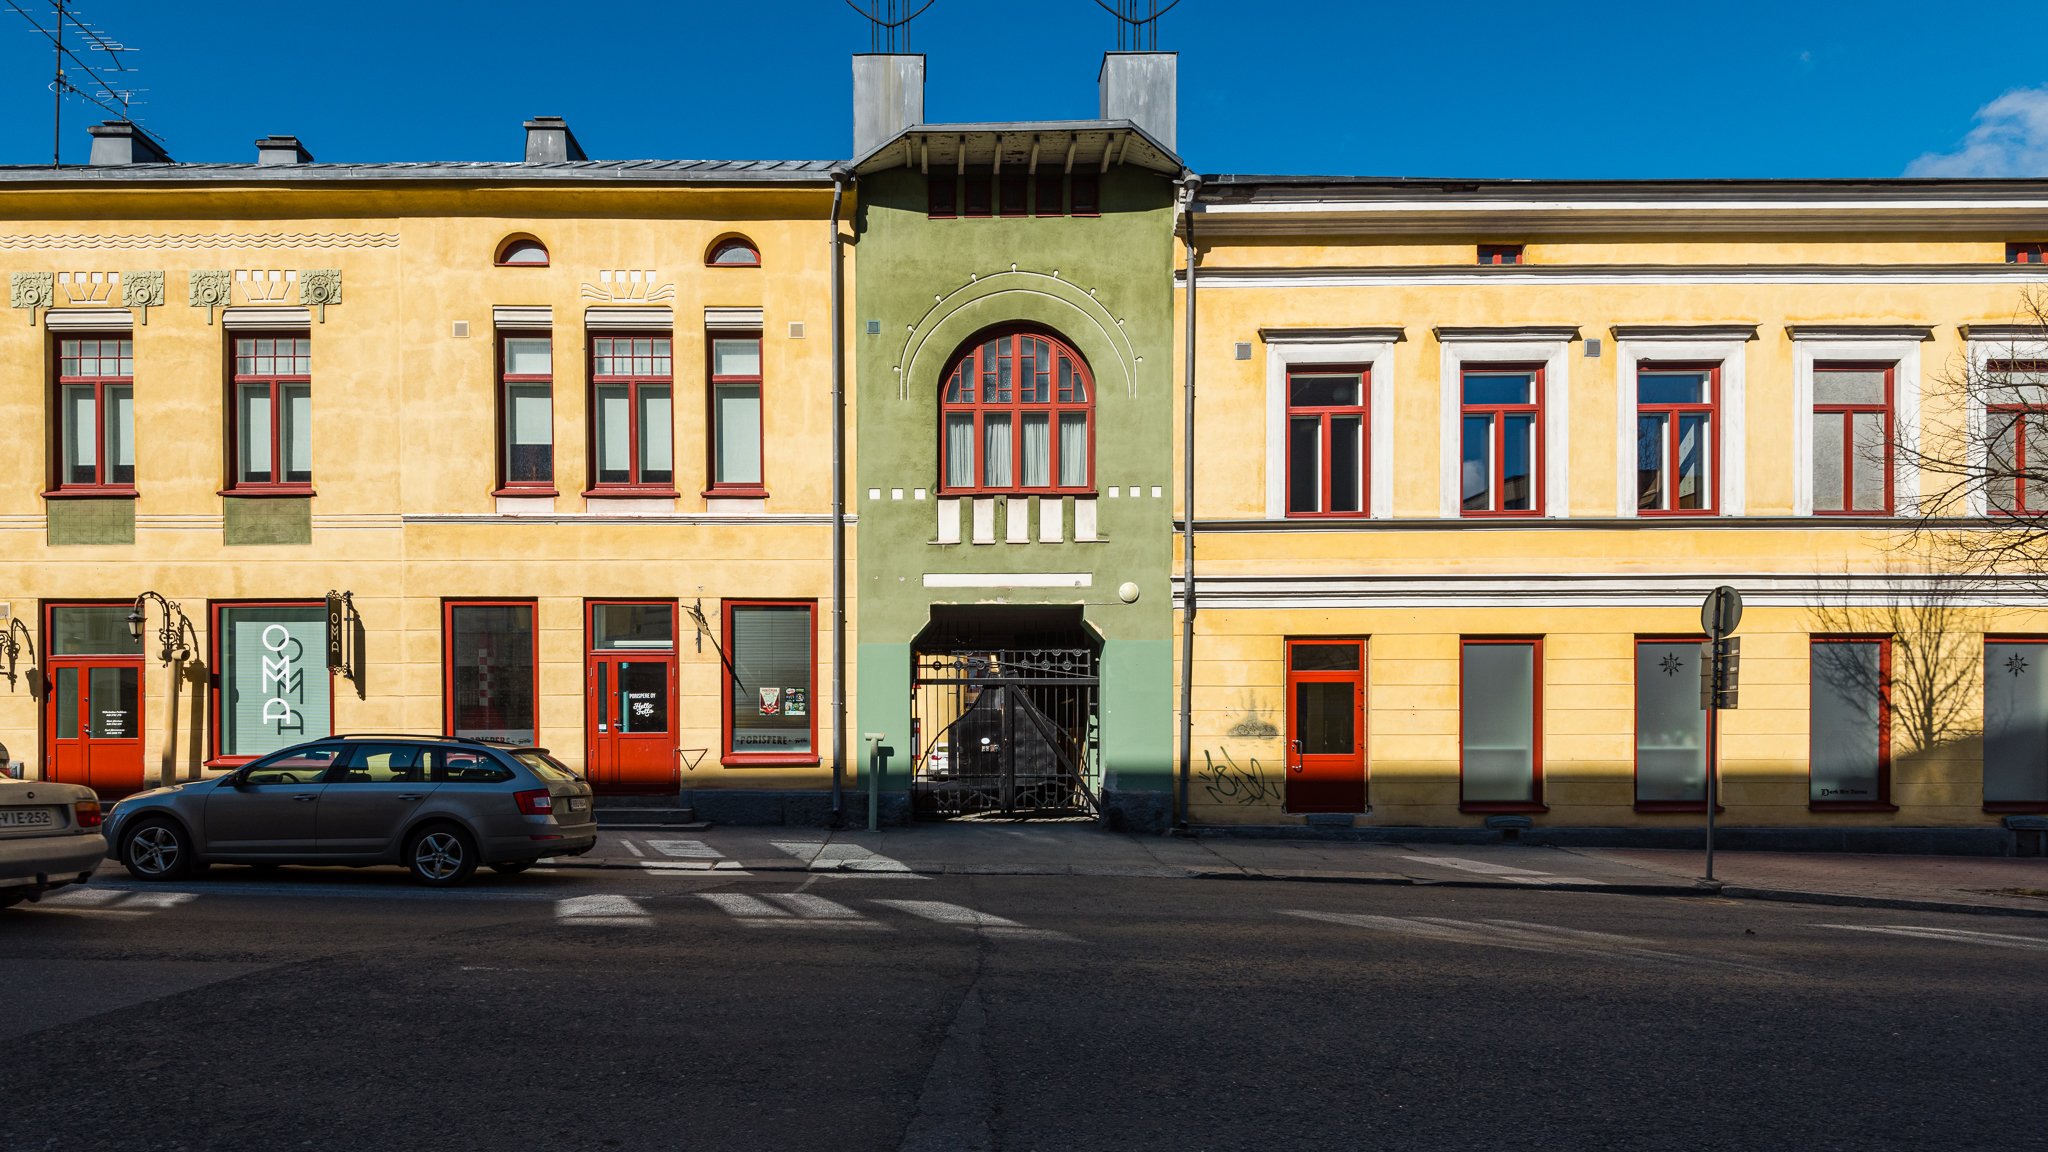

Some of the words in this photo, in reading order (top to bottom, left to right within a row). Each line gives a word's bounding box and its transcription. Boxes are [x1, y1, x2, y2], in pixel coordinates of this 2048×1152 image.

[331, 613, 339, 652] OMA
[262, 624, 290, 724] OMA
[740, 735, 787, 745] PORISPERE
